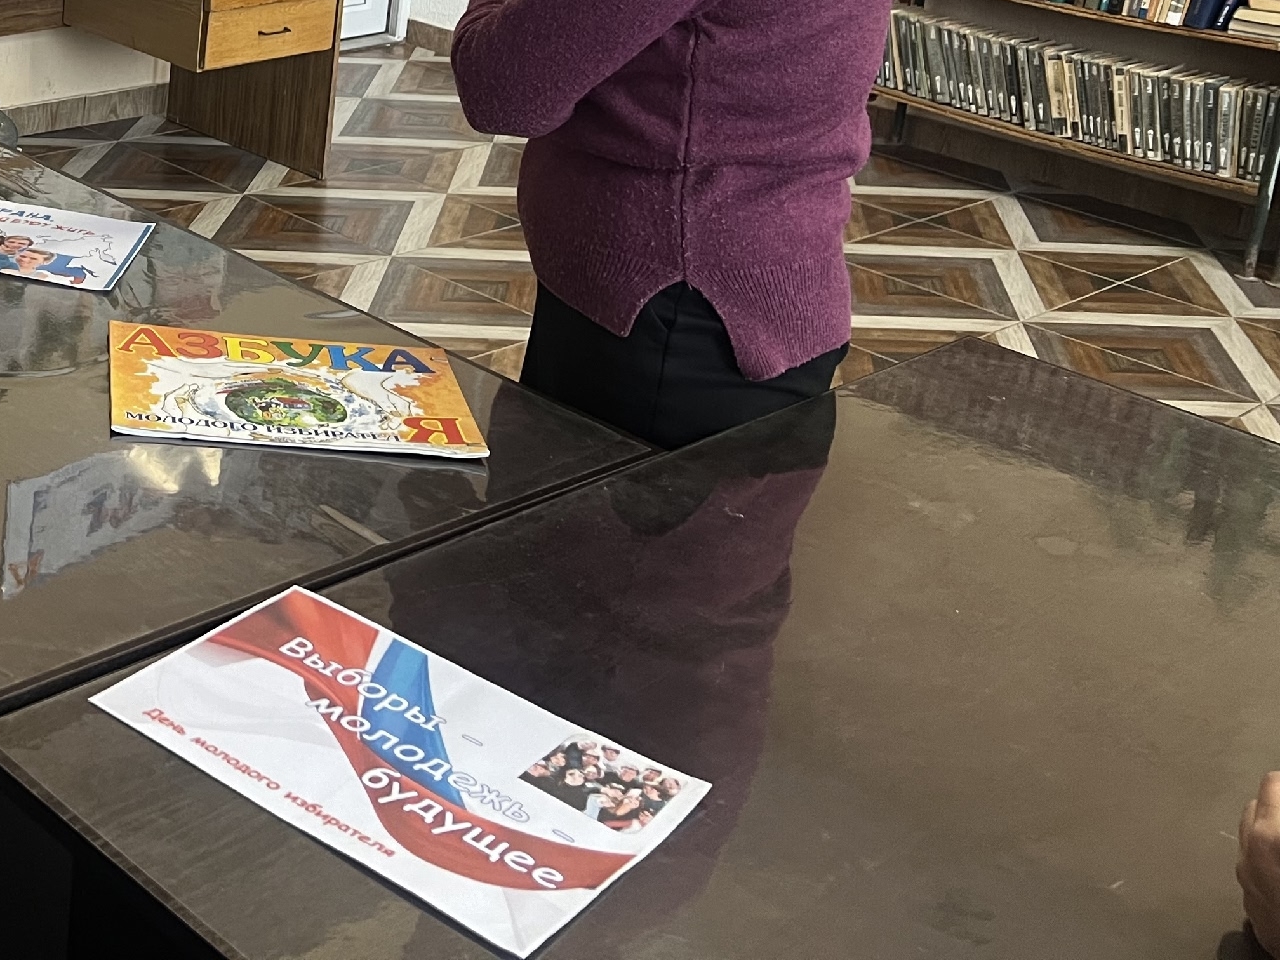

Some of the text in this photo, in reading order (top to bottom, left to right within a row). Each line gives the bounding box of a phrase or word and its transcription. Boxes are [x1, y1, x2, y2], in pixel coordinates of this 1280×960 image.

[55, 223, 96, 236] ЖИТЬ
[116, 326, 435, 374] АЗБУКА
[124, 410, 259, 432] МОЛОДОГО
[279, 636, 448, 733] Выборы
[142, 707, 397, 858] День молодого избирателя
[306, 696, 531, 824] молодежь
[362, 766, 566, 890] будущее
